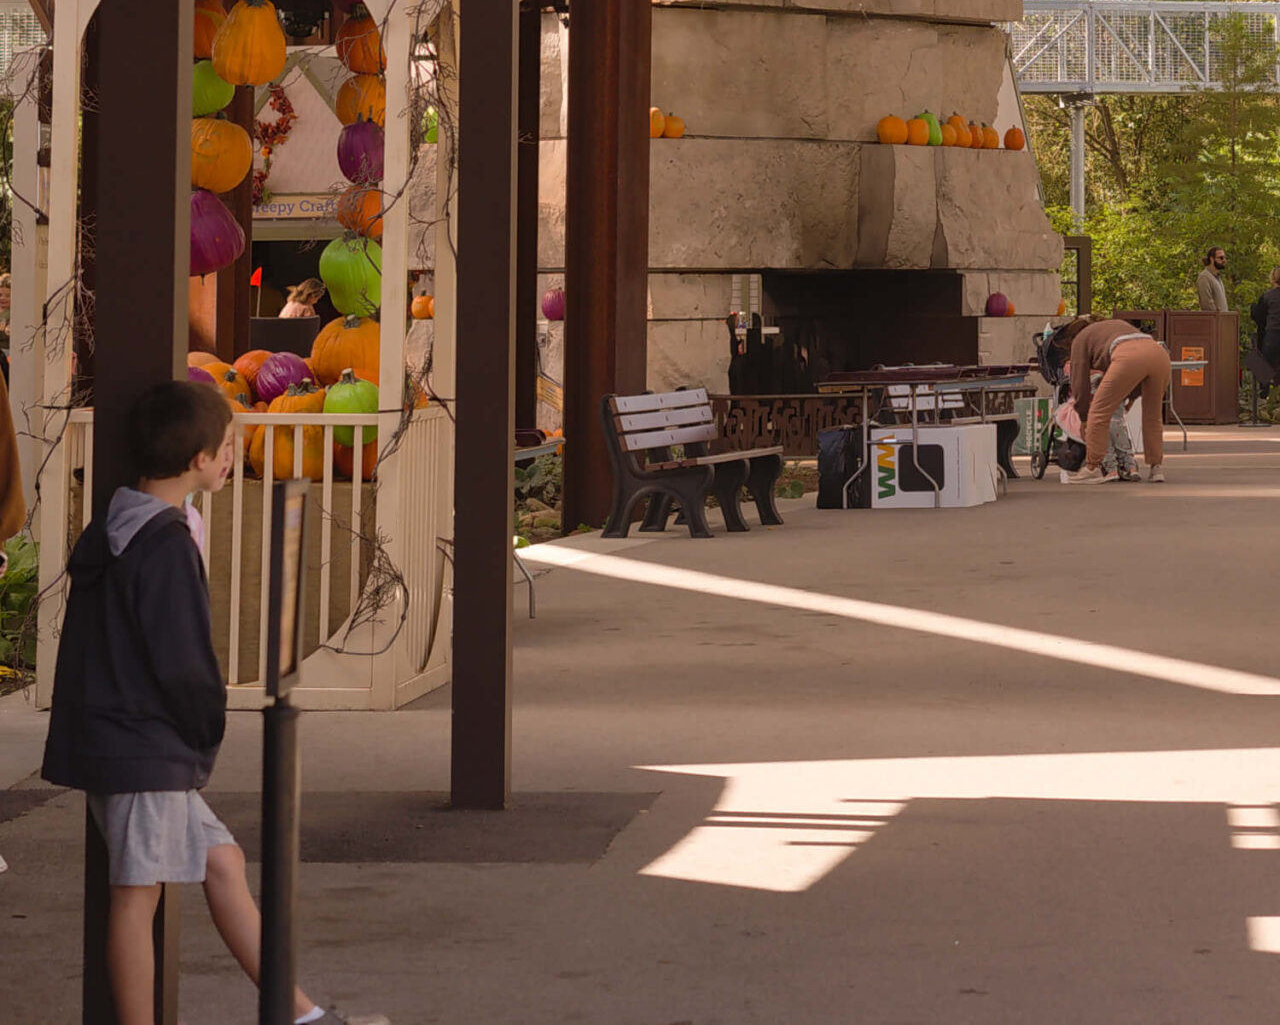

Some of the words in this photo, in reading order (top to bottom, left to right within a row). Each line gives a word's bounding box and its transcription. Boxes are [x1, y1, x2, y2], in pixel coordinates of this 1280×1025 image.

[252, 202, 295, 215] reepy
[1025, 410, 1033, 446] RECYCLE
[877, 434, 896, 500] WM
